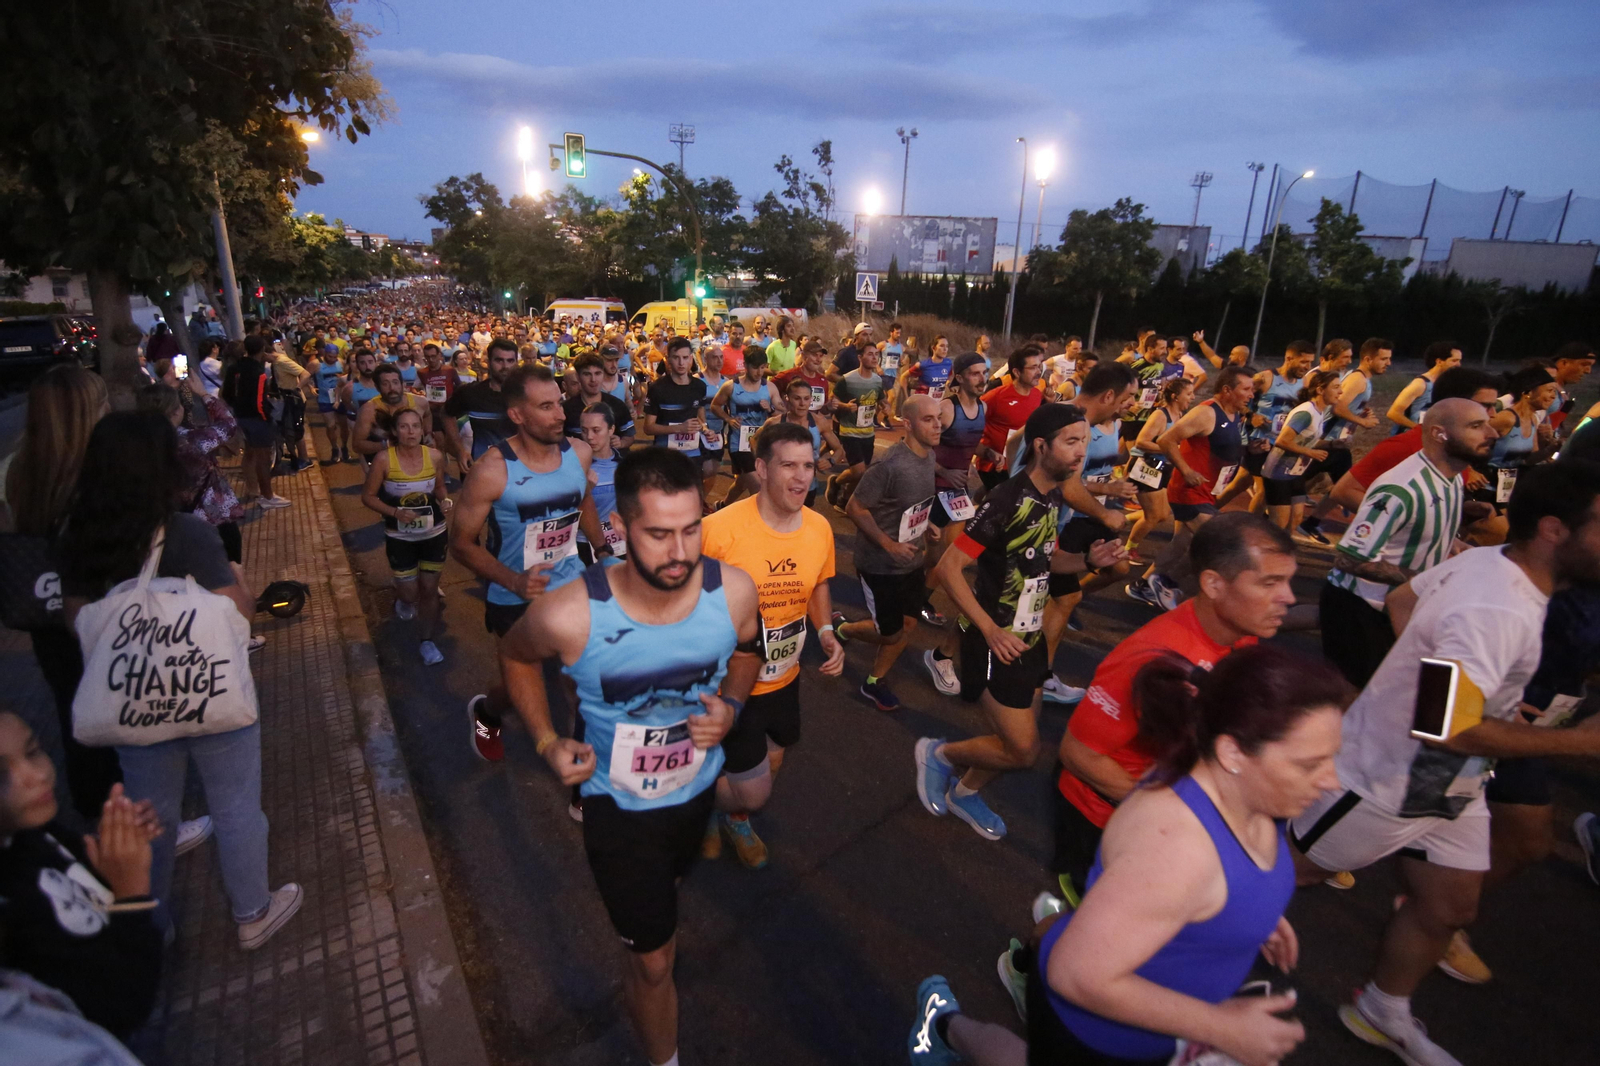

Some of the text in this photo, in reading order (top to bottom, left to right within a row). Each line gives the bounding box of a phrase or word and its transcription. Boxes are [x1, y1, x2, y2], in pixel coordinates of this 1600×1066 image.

[675, 433, 695, 441] 1701
[1140, 466, 1159, 478] 1108
[949, 499, 968, 511] 1171
[538, 531, 570, 549] 1233
[111, 603, 197, 656] Small
[768, 629, 783, 642] 21
[165, 647, 214, 670] acts
[108, 652, 230, 701] CHANGE
[146, 698, 178, 711] THE
[647, 729, 669, 747] 21
[635, 748, 691, 772] 1761
